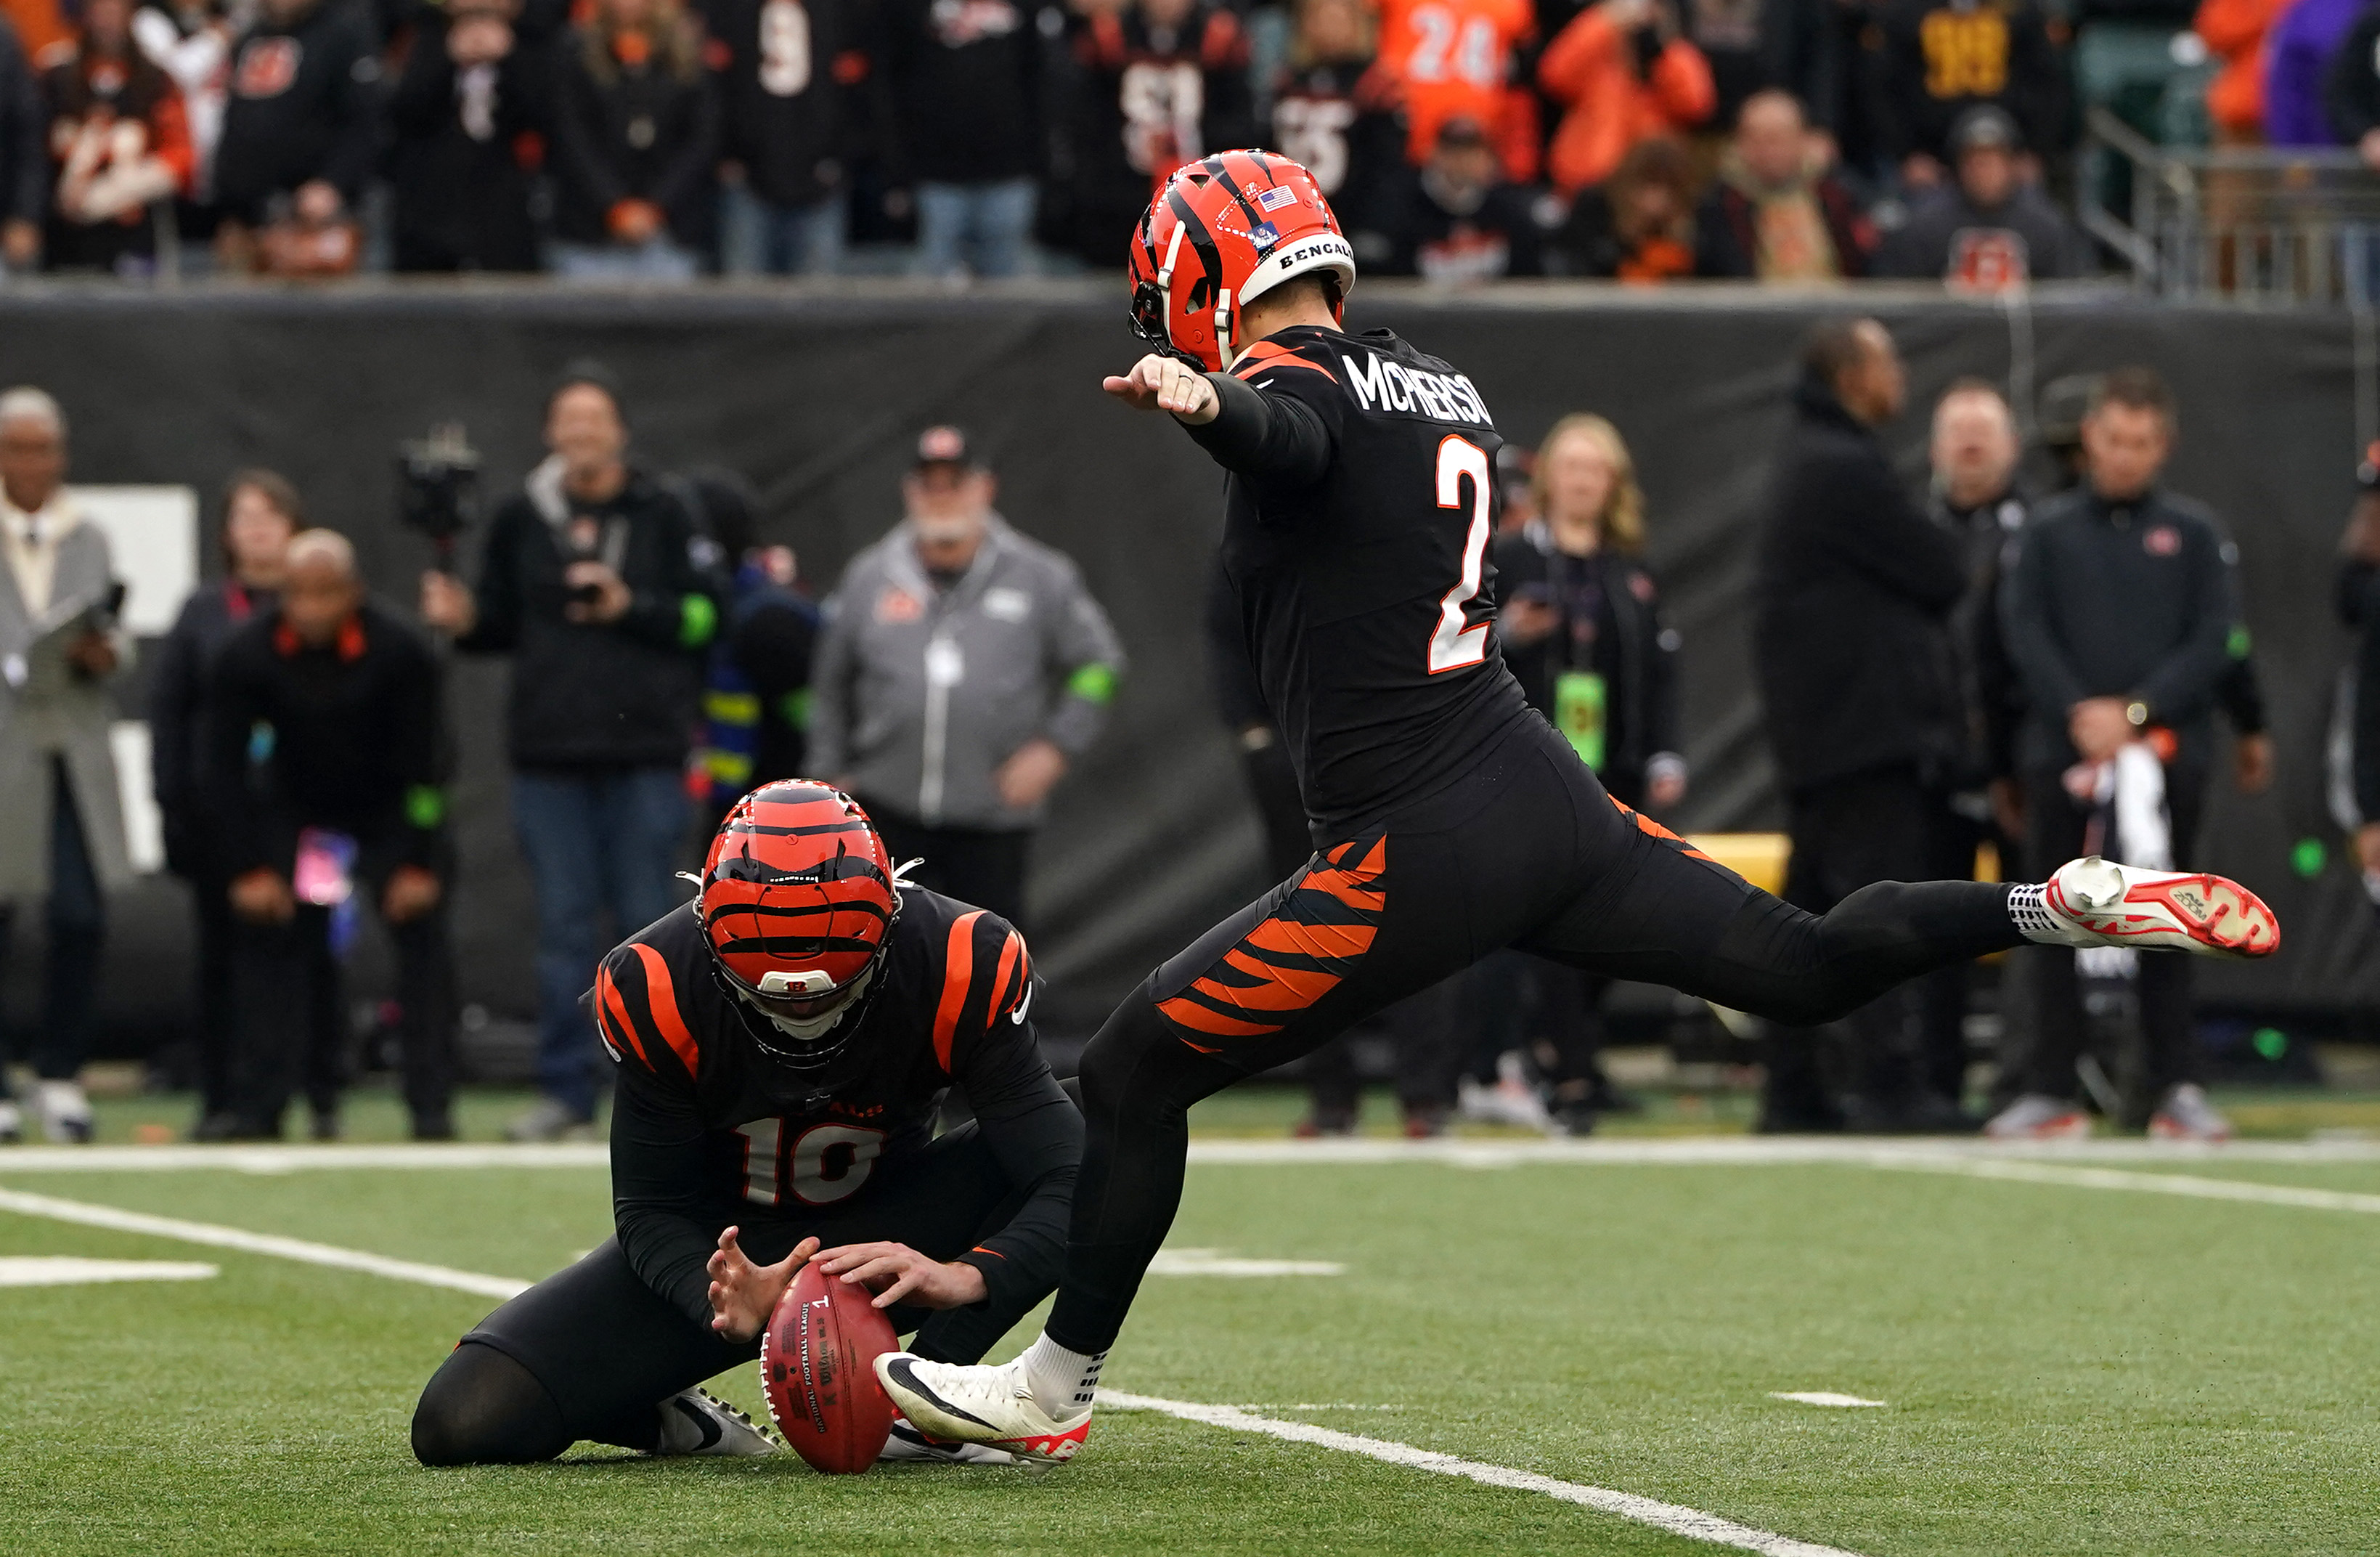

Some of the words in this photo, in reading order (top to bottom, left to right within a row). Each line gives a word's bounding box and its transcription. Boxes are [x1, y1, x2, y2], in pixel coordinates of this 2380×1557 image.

[1279, 243, 1354, 269] BENGAL
[1427, 434, 1491, 675] 2
[2173, 890, 2207, 920] ZOOM
[733, 1117, 886, 1206] 10
[800, 1301, 810, 1336] LEAGUE
[812, 1295, 829, 1309] 1
[800, 1337, 812, 1386] FOOTBALL
[807, 1389, 826, 1434] NATIONAL
